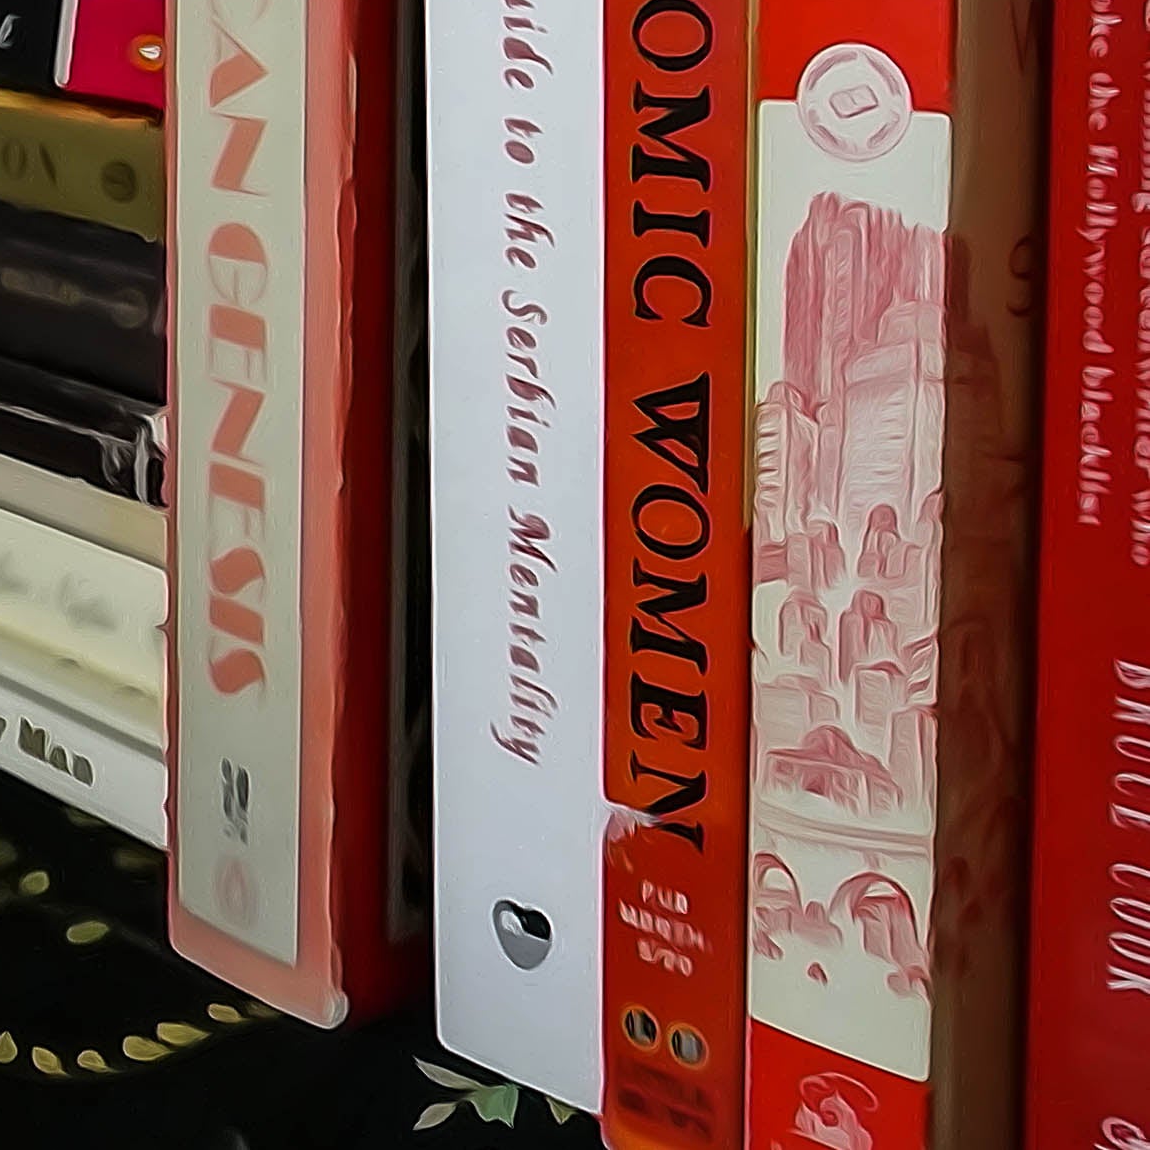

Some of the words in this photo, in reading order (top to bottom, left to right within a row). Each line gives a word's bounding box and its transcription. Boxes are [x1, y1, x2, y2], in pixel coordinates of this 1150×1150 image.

[503, 117, 543, 165] to
[1088, 72, 1120, 132] the
[504, 192, 555, 269] the
[1076, 144, 1120, 354] Hollywood
[206, 221, 268, 702] GENESIS
[502, 289, 556, 487] Serbian
[1076, 366, 1116, 526] blacklist
[490, 504, 558, 767] Mentality
[629, 371, 712, 855] WOMEN
